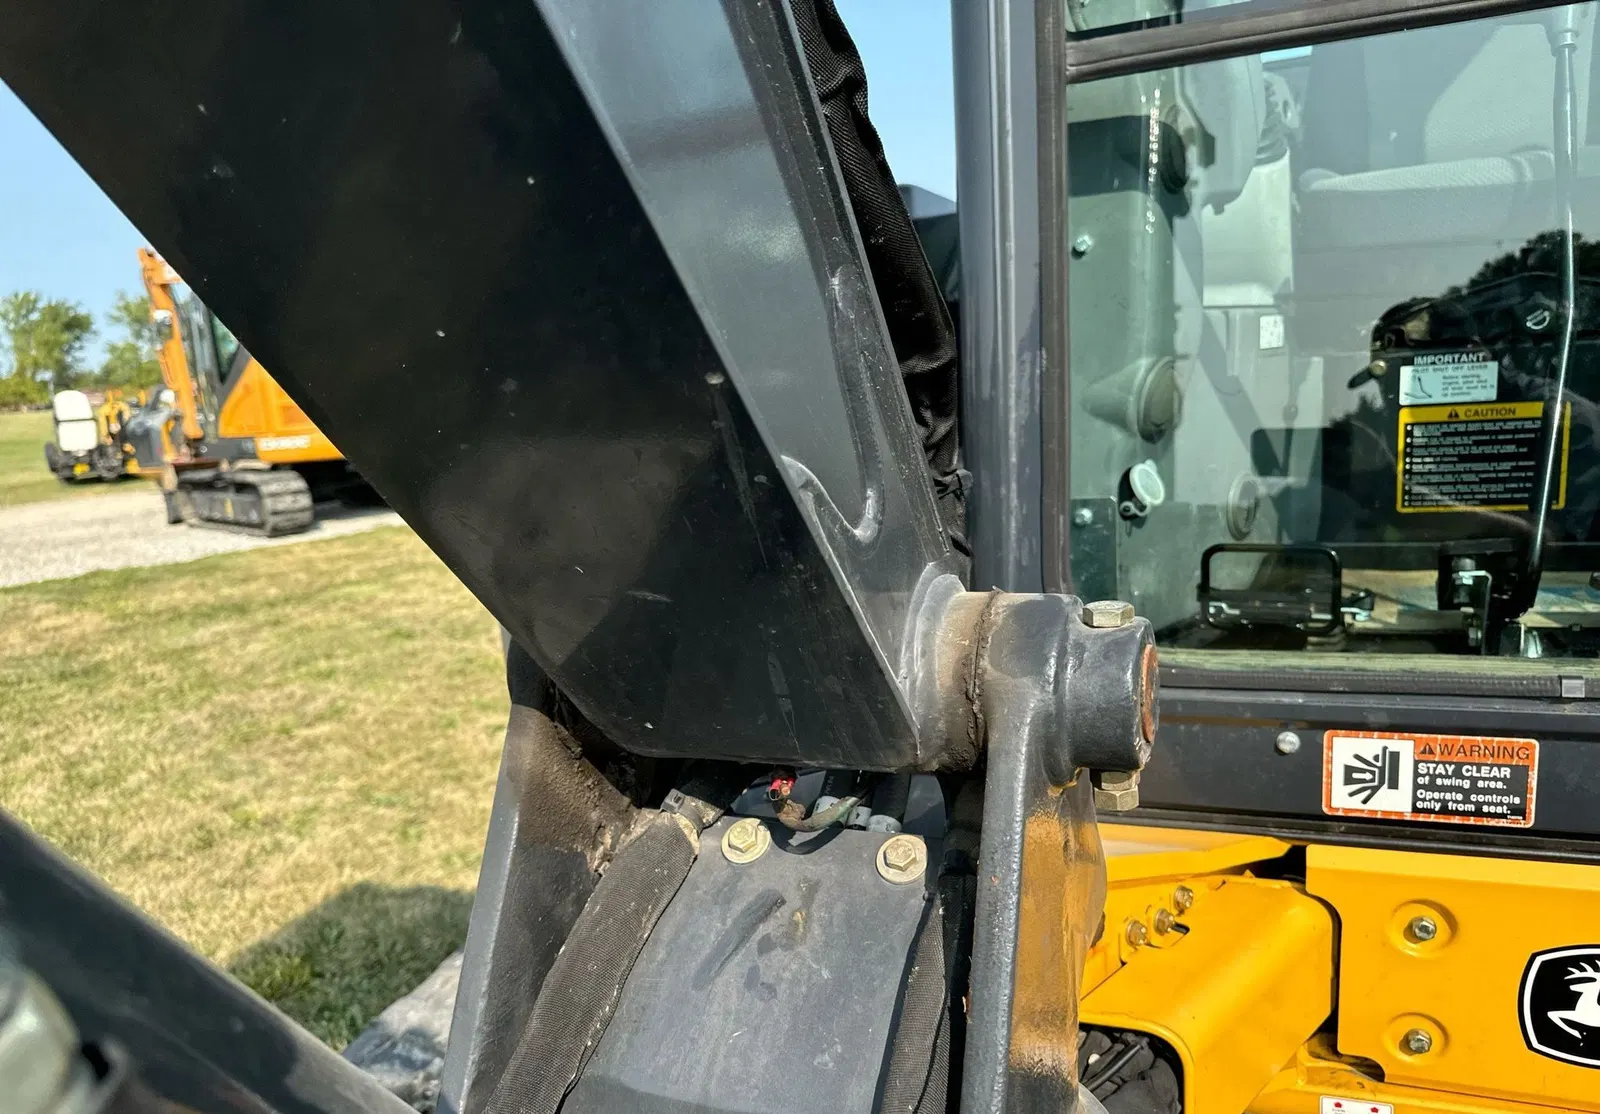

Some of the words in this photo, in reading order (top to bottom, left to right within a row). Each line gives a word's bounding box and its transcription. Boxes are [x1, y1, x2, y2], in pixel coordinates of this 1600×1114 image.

[1413, 351, 1486, 365] IMPORTANT
[1464, 407, 1516, 418] CAUTION
[1438, 743, 1530, 760] WARNING
[1417, 762, 1456, 775] STAY
[1461, 764, 1511, 778] CLEAR
[1416, 775, 1430, 785] of
[1435, 776, 1471, 789] swing
[1476, 779, 1507, 789] area.
[1416, 788, 1464, 801] Operate
[1469, 793, 1521, 805] controls
[1415, 800, 1442, 812] only
[1447, 800, 1476, 812] from
[1481, 804, 1511, 814] seat.
